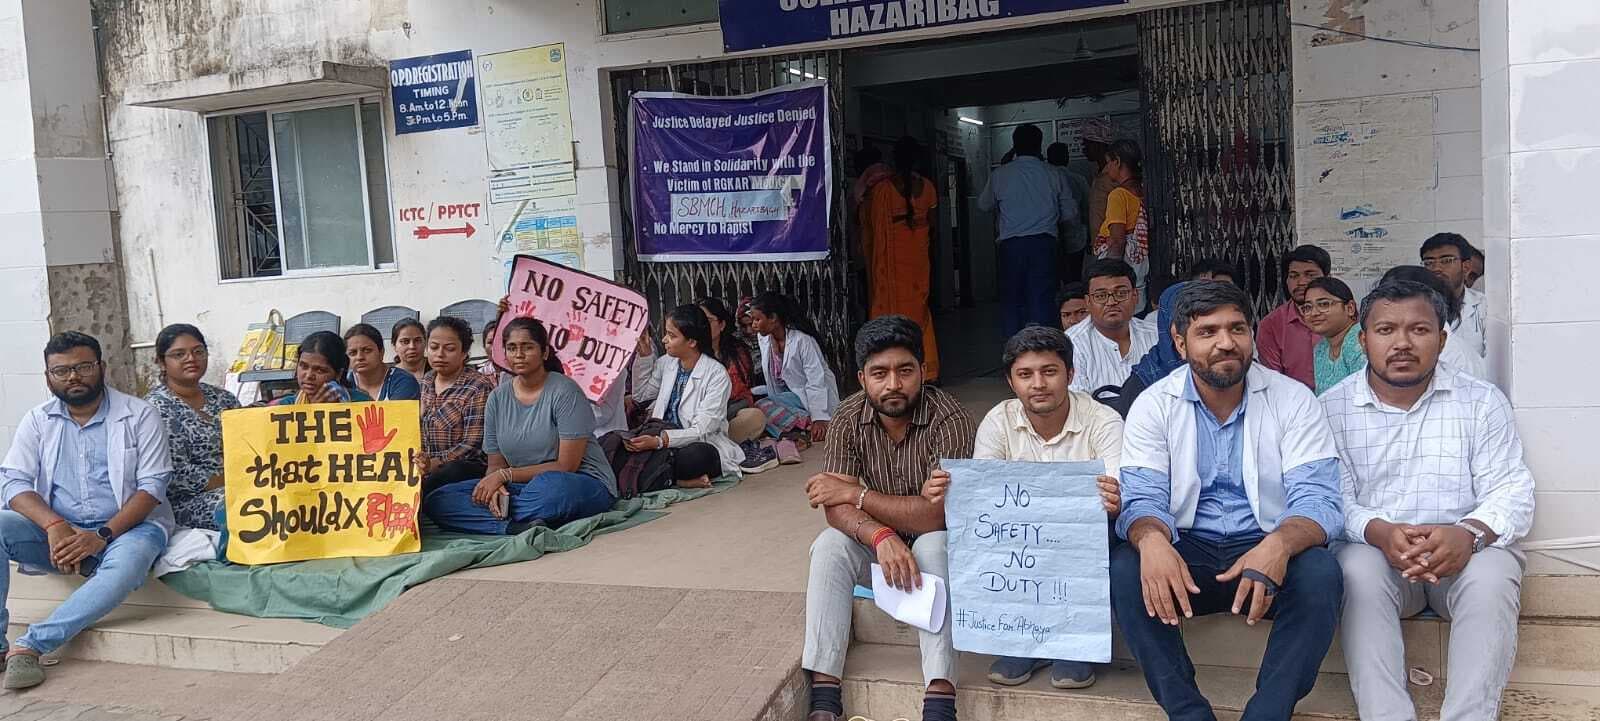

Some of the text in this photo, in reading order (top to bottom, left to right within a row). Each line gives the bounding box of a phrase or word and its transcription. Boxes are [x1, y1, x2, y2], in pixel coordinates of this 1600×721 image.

[413, 85, 449, 98] TIMING
[652, 105, 816, 129] Justice Delayed Justice Denied
[653, 154, 816, 173] We Stand in Solidarity with the
[667, 178, 699, 191] Victim
[702, 178, 711, 190] of
[399, 207, 425, 221] ICTC
[438, 203, 480, 219] PPTCT
[654, 222, 754, 236] No Mercy to Rapist
[521, 270, 648, 332] NO SAFETY
[575, 335, 631, 373] DUTY
[270, 408, 352, 444] THE
[245, 453, 322, 490] that
[238, 491, 342, 543] Should
[979, 571, 1042, 603] DUTY
